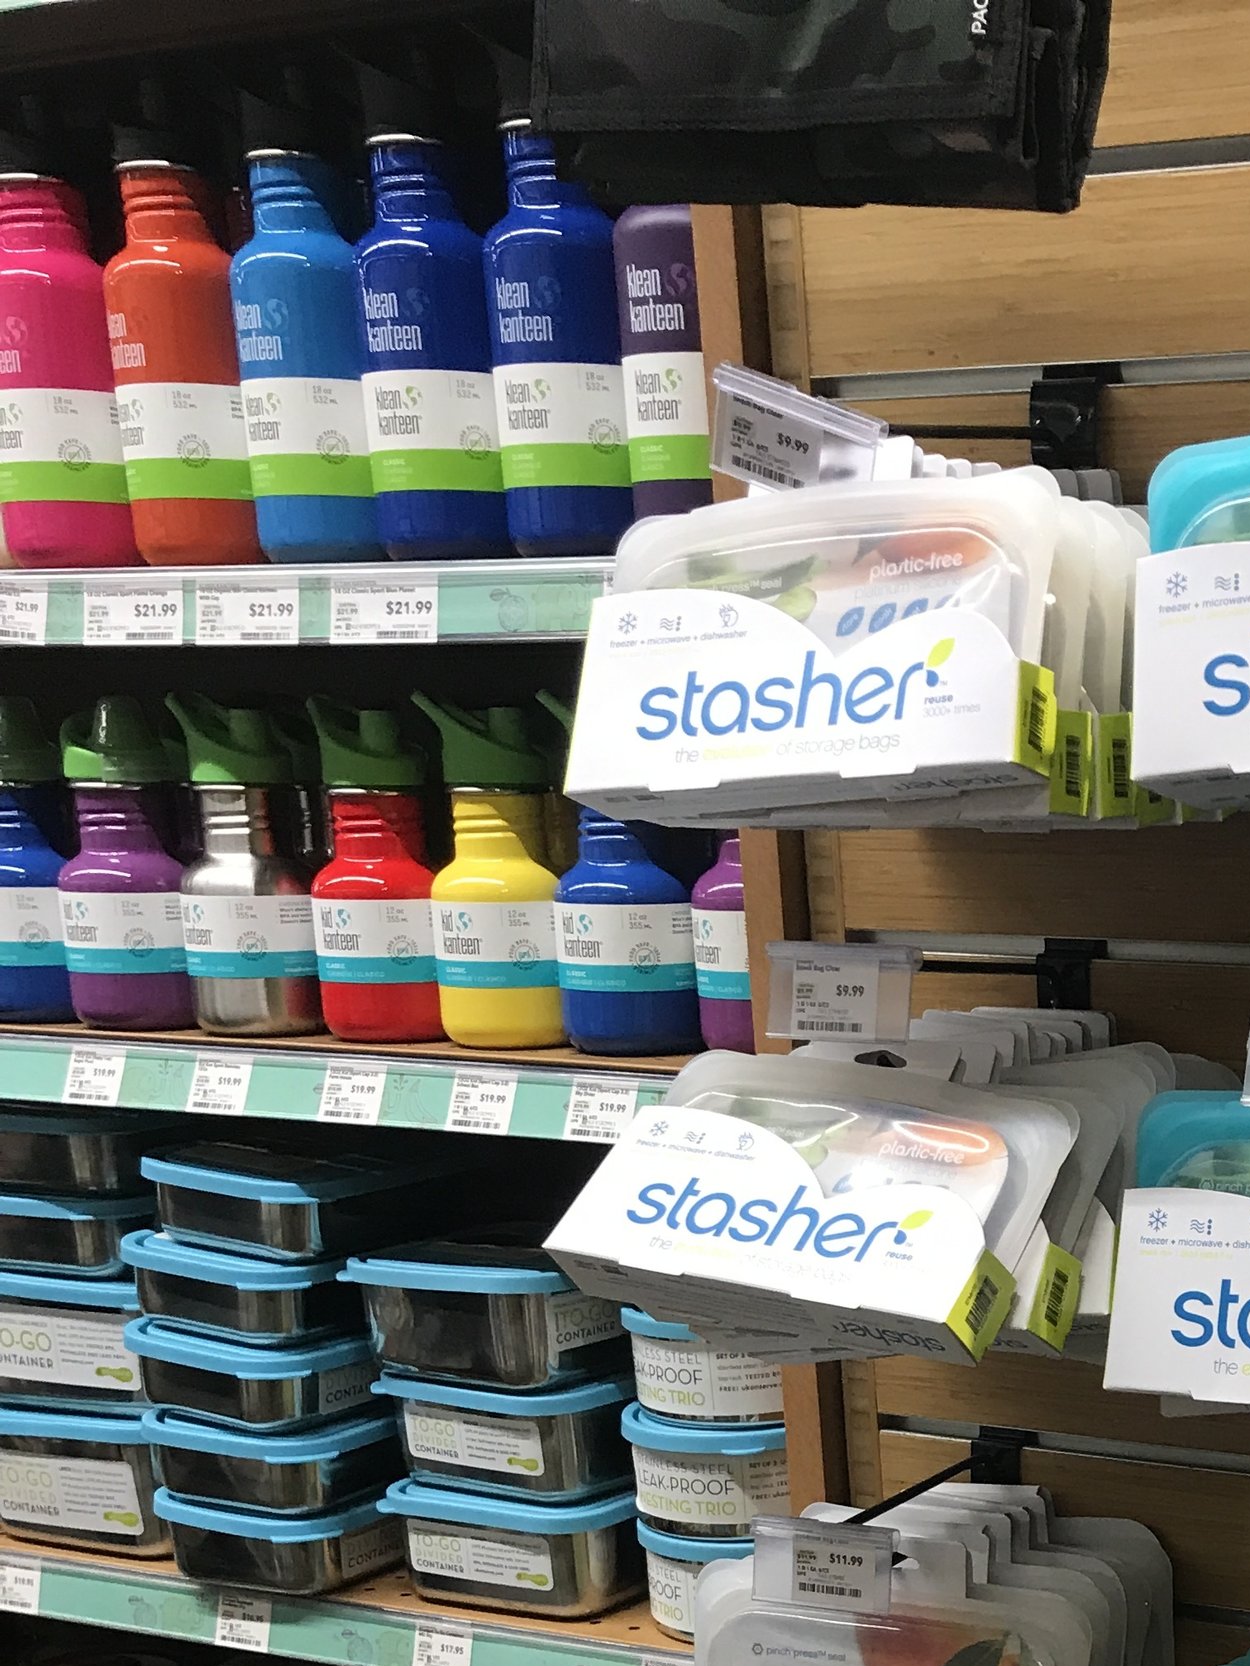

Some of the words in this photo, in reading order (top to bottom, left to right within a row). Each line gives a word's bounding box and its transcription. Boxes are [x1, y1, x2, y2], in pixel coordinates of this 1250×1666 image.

[626, 264, 662, 298] klean
[496, 277, 530, 310] klean
[363, 288, 399, 321] klean
[629, 298, 685, 334] kanteen
[499, 312, 554, 344] kanteen
[366, 322, 423, 354] kanteen
[634, 368, 661, 395] klean
[374, 386, 402, 411] klean
[504, 378, 531, 404] klean
[776, 432, 810, 455] $9.99
[868, 550, 964, 581] plastic-free
[15, 602, 39, 614] $21.99
[134, 603, 178, 618] $21.99
[249, 602, 294, 618] $21.99
[386, 600, 433, 616] $21.99
[1158, 602, 1190, 615] freezer
[636, 650, 926, 742] stasher
[923, 693, 954, 706] reuse
[674, 746, 700, 764] the
[776, 737, 796, 757] of
[795, 734, 857, 758] storage
[858, 732, 901, 754] bags
[835, 983, 865, 998] $9.99
[93, 1068, 116, 1079] $19.99
[217, 1076, 242, 1087] $19.99
[350, 1084, 376, 1096] $19.99
[479, 1092, 507, 1104] $19.99
[599, 1101, 627, 1114] $19.99
[877, 1142, 967, 1165] plastic-free
[626, 1176, 900, 1263] stasher
[1140, 1236, 1170, 1247] freezer
[1178, 1238, 1224, 1250] microwave
[1213, 1359, 1239, 1377] the
[667, 1387, 706, 1407] TRIO
[410, 1416, 455, 1437] TO-GO
[415, 1442, 460, 1460] CONTAINER
[694, 1462, 735, 1475] STEEL
[638, 1469, 735, 1497] LEAK-PROOF
[695, 1500, 737, 1517] TRIO
[415, 1534, 461, 1553] TO-GO
[416, 1557, 465, 1574] CONTAINER
[829, 1551, 864, 1568] $11.99
[440, 1643, 464, 1656] $17.95
